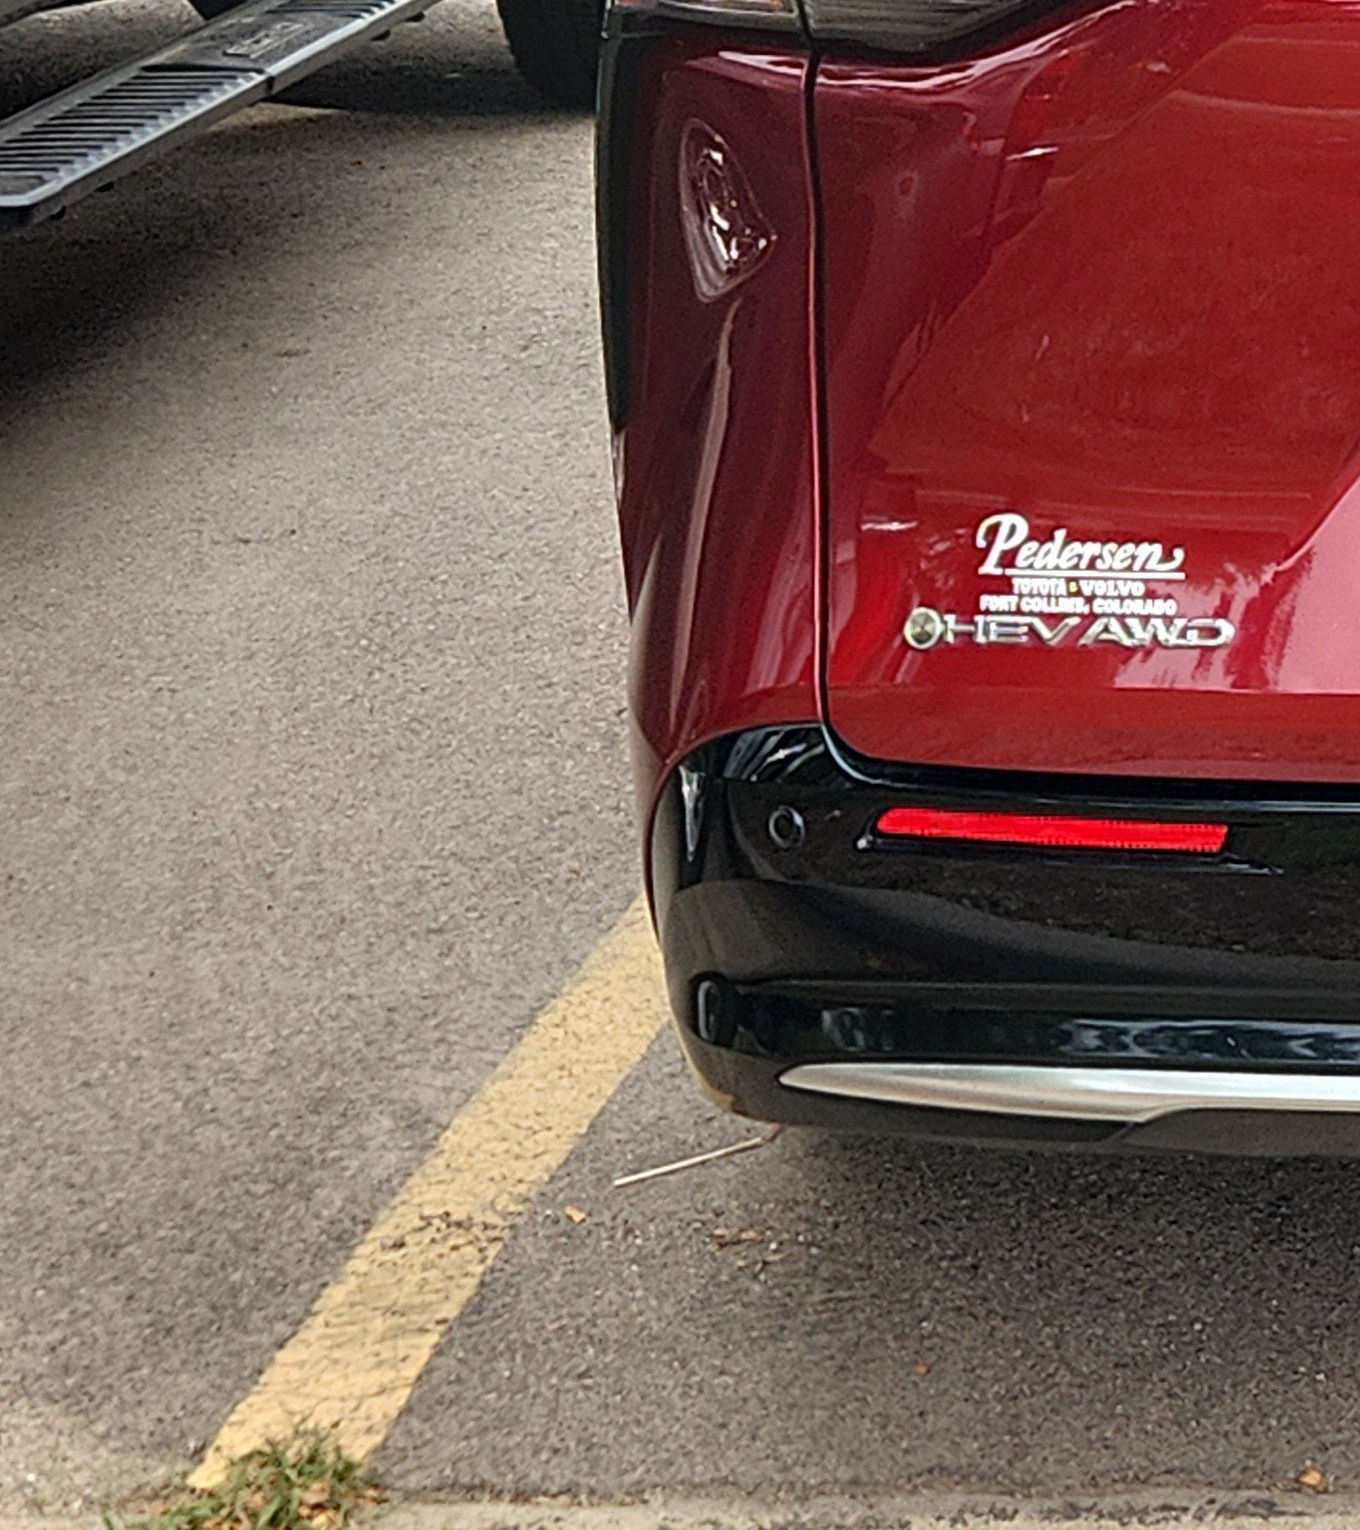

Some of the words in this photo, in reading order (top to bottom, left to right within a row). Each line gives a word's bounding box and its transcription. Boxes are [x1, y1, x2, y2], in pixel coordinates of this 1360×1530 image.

[976, 513, 1186, 574] Pedersen
[1012, 577, 1067, 596] TOYOTA
[1078, 579, 1145, 596] VOLVO
[979, 594, 1018, 612] FORT
[1093, 598, 1178, 615] COLORADO
[1078, 616, 1236, 647] AWD
